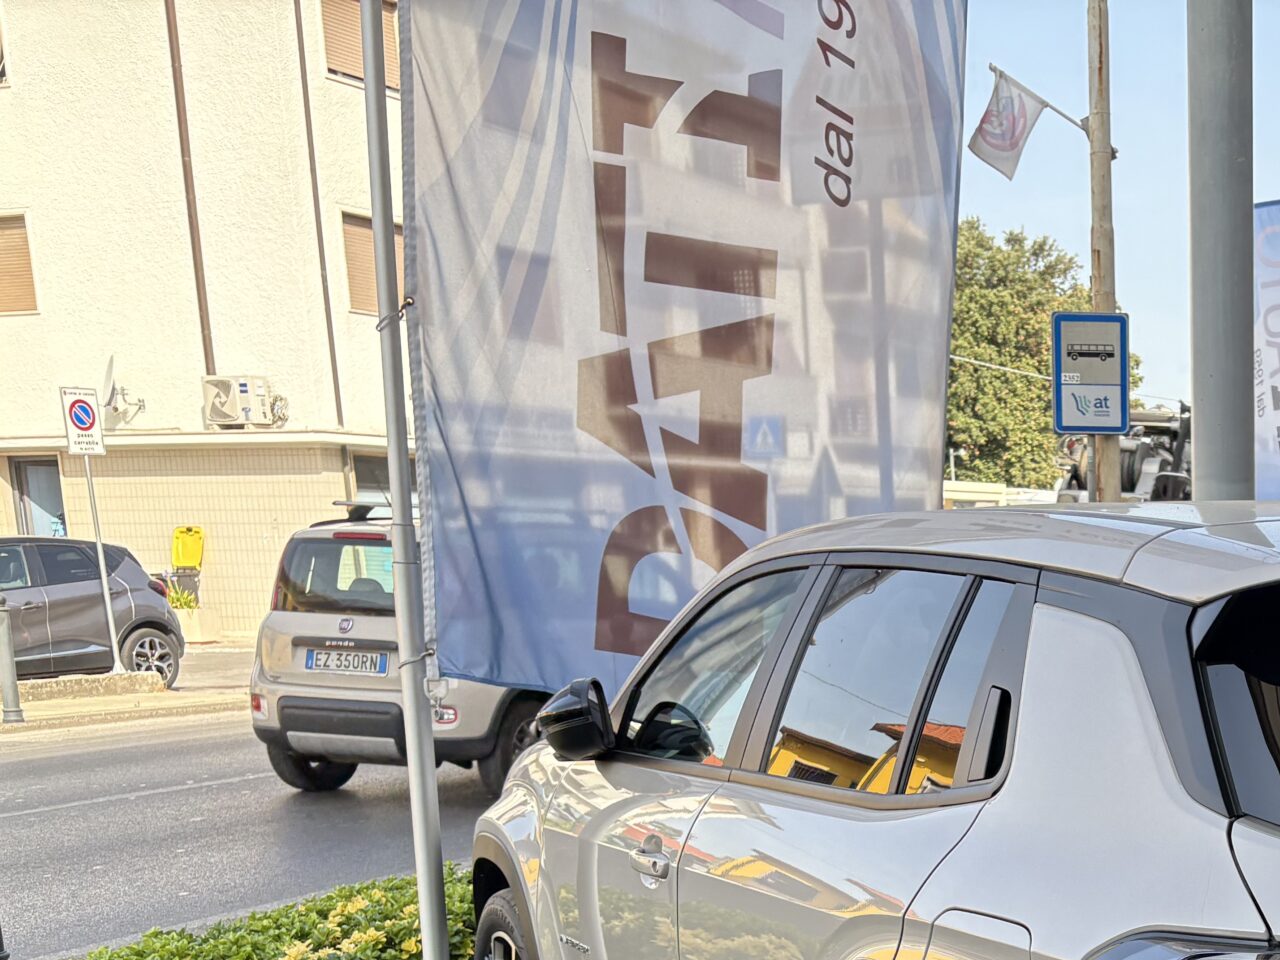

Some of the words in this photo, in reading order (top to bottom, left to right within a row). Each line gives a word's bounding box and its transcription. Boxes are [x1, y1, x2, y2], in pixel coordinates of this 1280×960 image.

[814, 95, 854, 208] dal
[577, 30, 784, 655] DATI
[1093, 395, 1110, 409] at
[314, 651, 331, 668] EZ
[335, 652, 379, 671] 350RN
